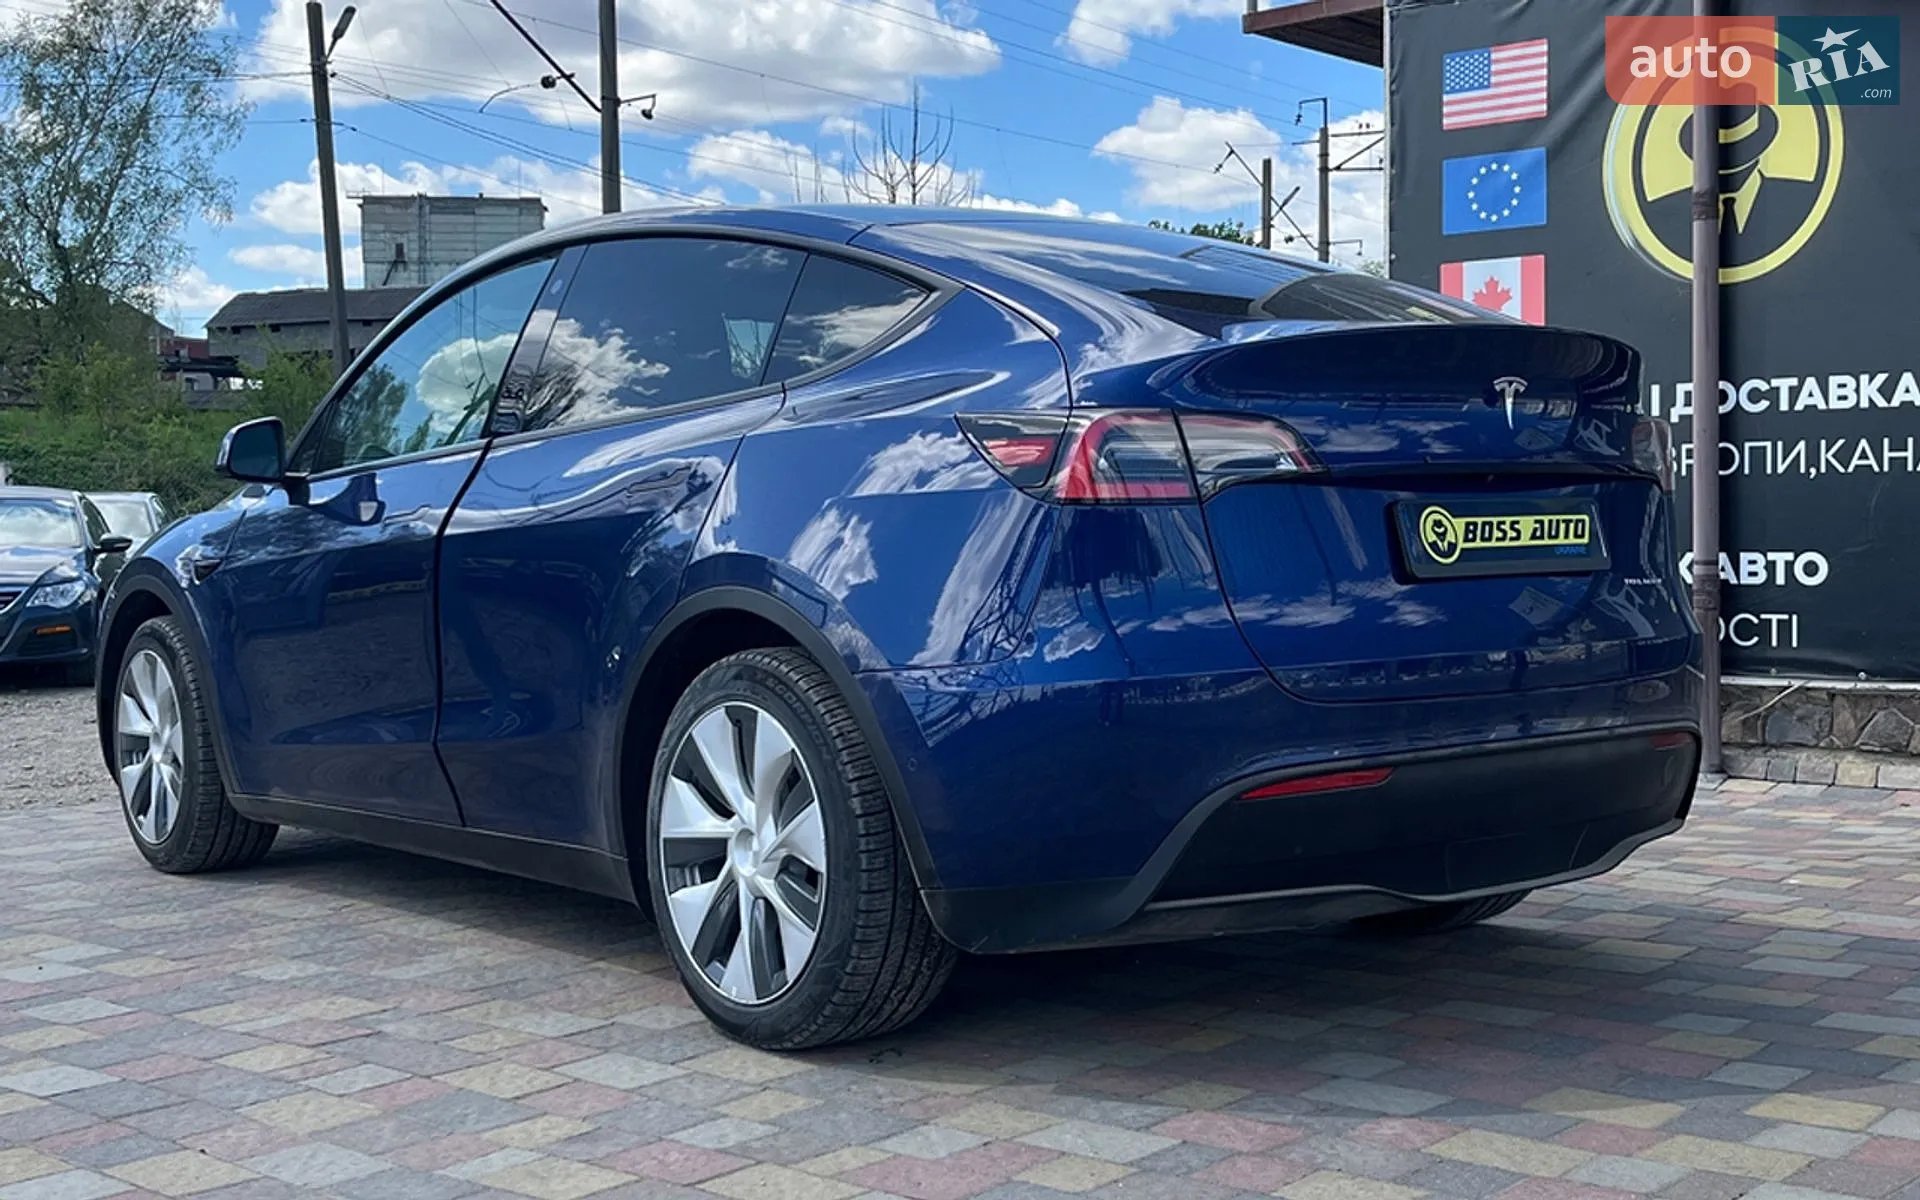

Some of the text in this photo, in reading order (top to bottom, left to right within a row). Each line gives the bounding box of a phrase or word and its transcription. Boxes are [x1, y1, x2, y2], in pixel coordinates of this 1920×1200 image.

[1462, 518, 1587, 543] BOSS AUTO
[1718, 612, 1799, 648] СТІ
